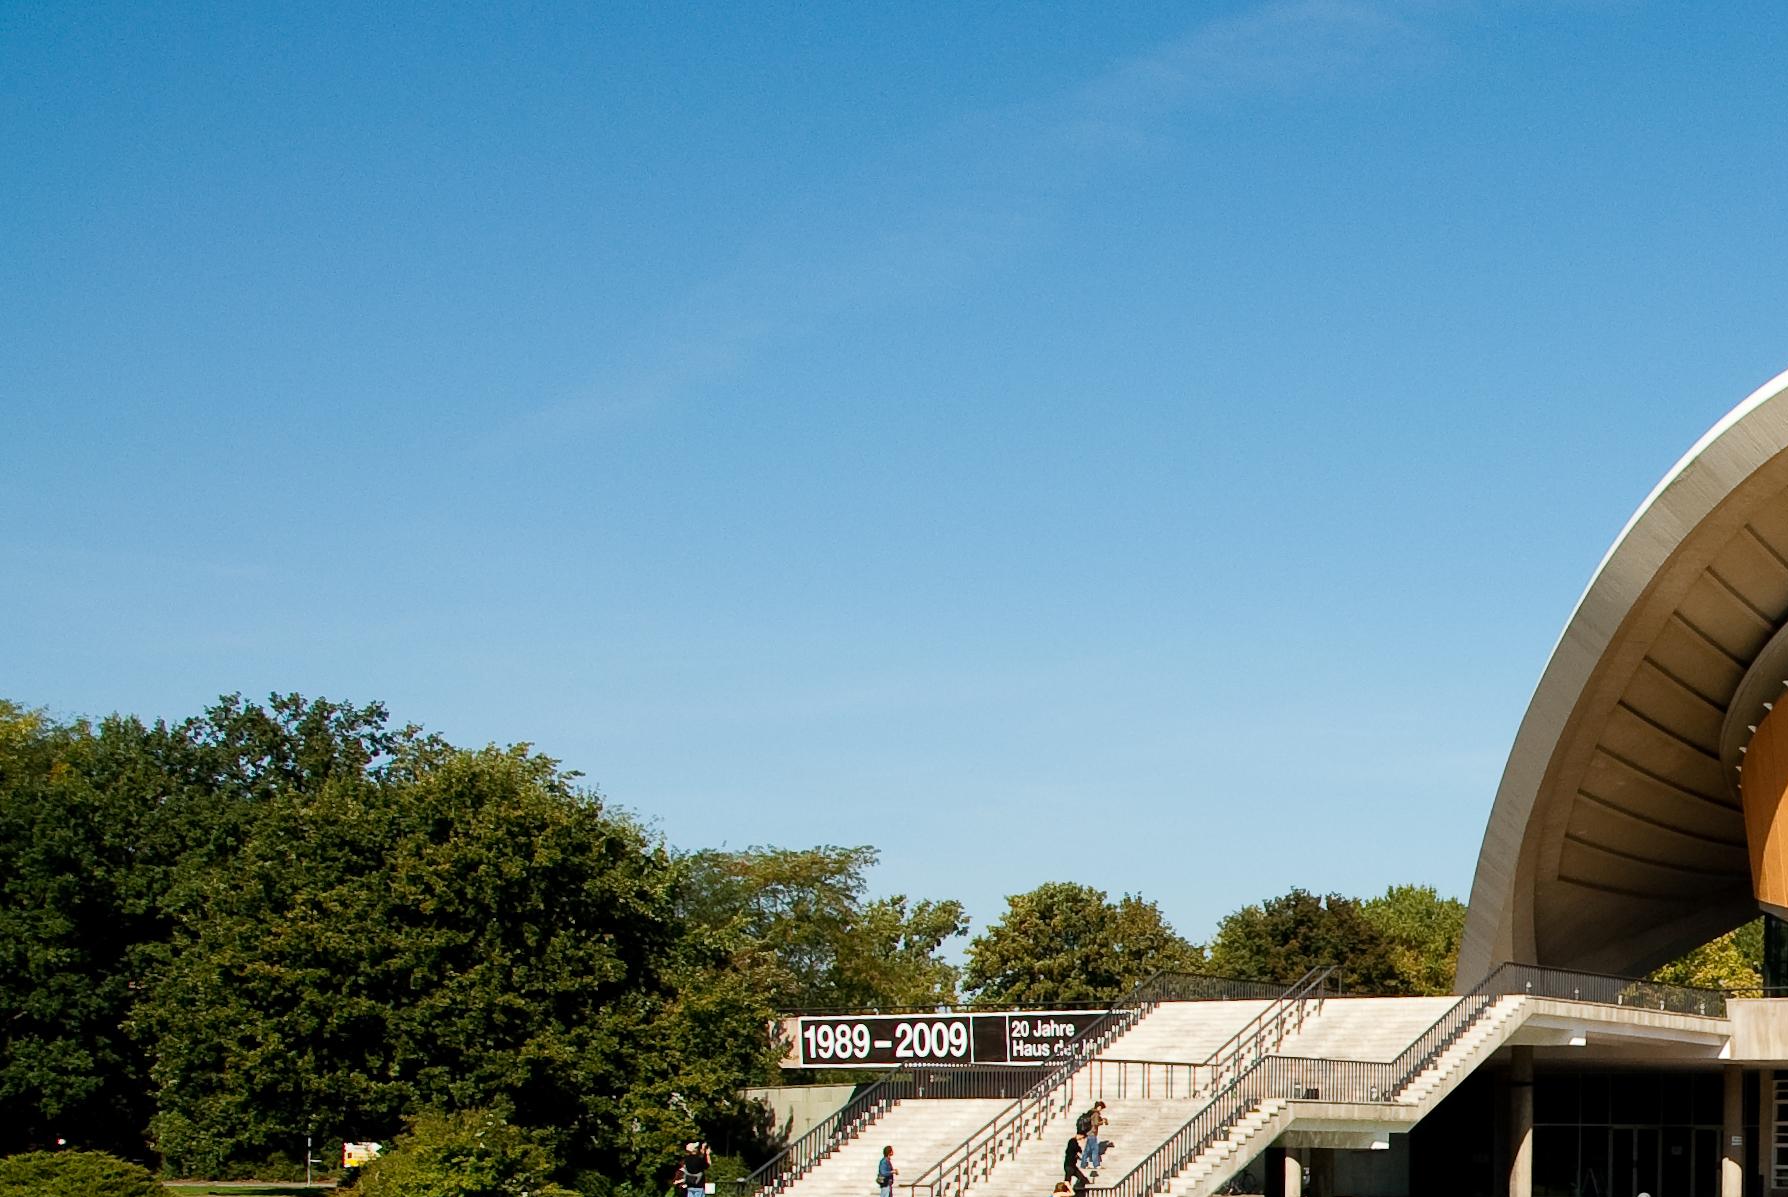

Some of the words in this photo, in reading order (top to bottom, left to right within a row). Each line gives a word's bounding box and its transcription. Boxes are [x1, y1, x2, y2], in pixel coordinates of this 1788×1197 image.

[1011, 1020, 1030, 1038] 20
[1033, 1019, 1075, 1037] Jahre
[1012, 1039, 1051, 1057] Haus
